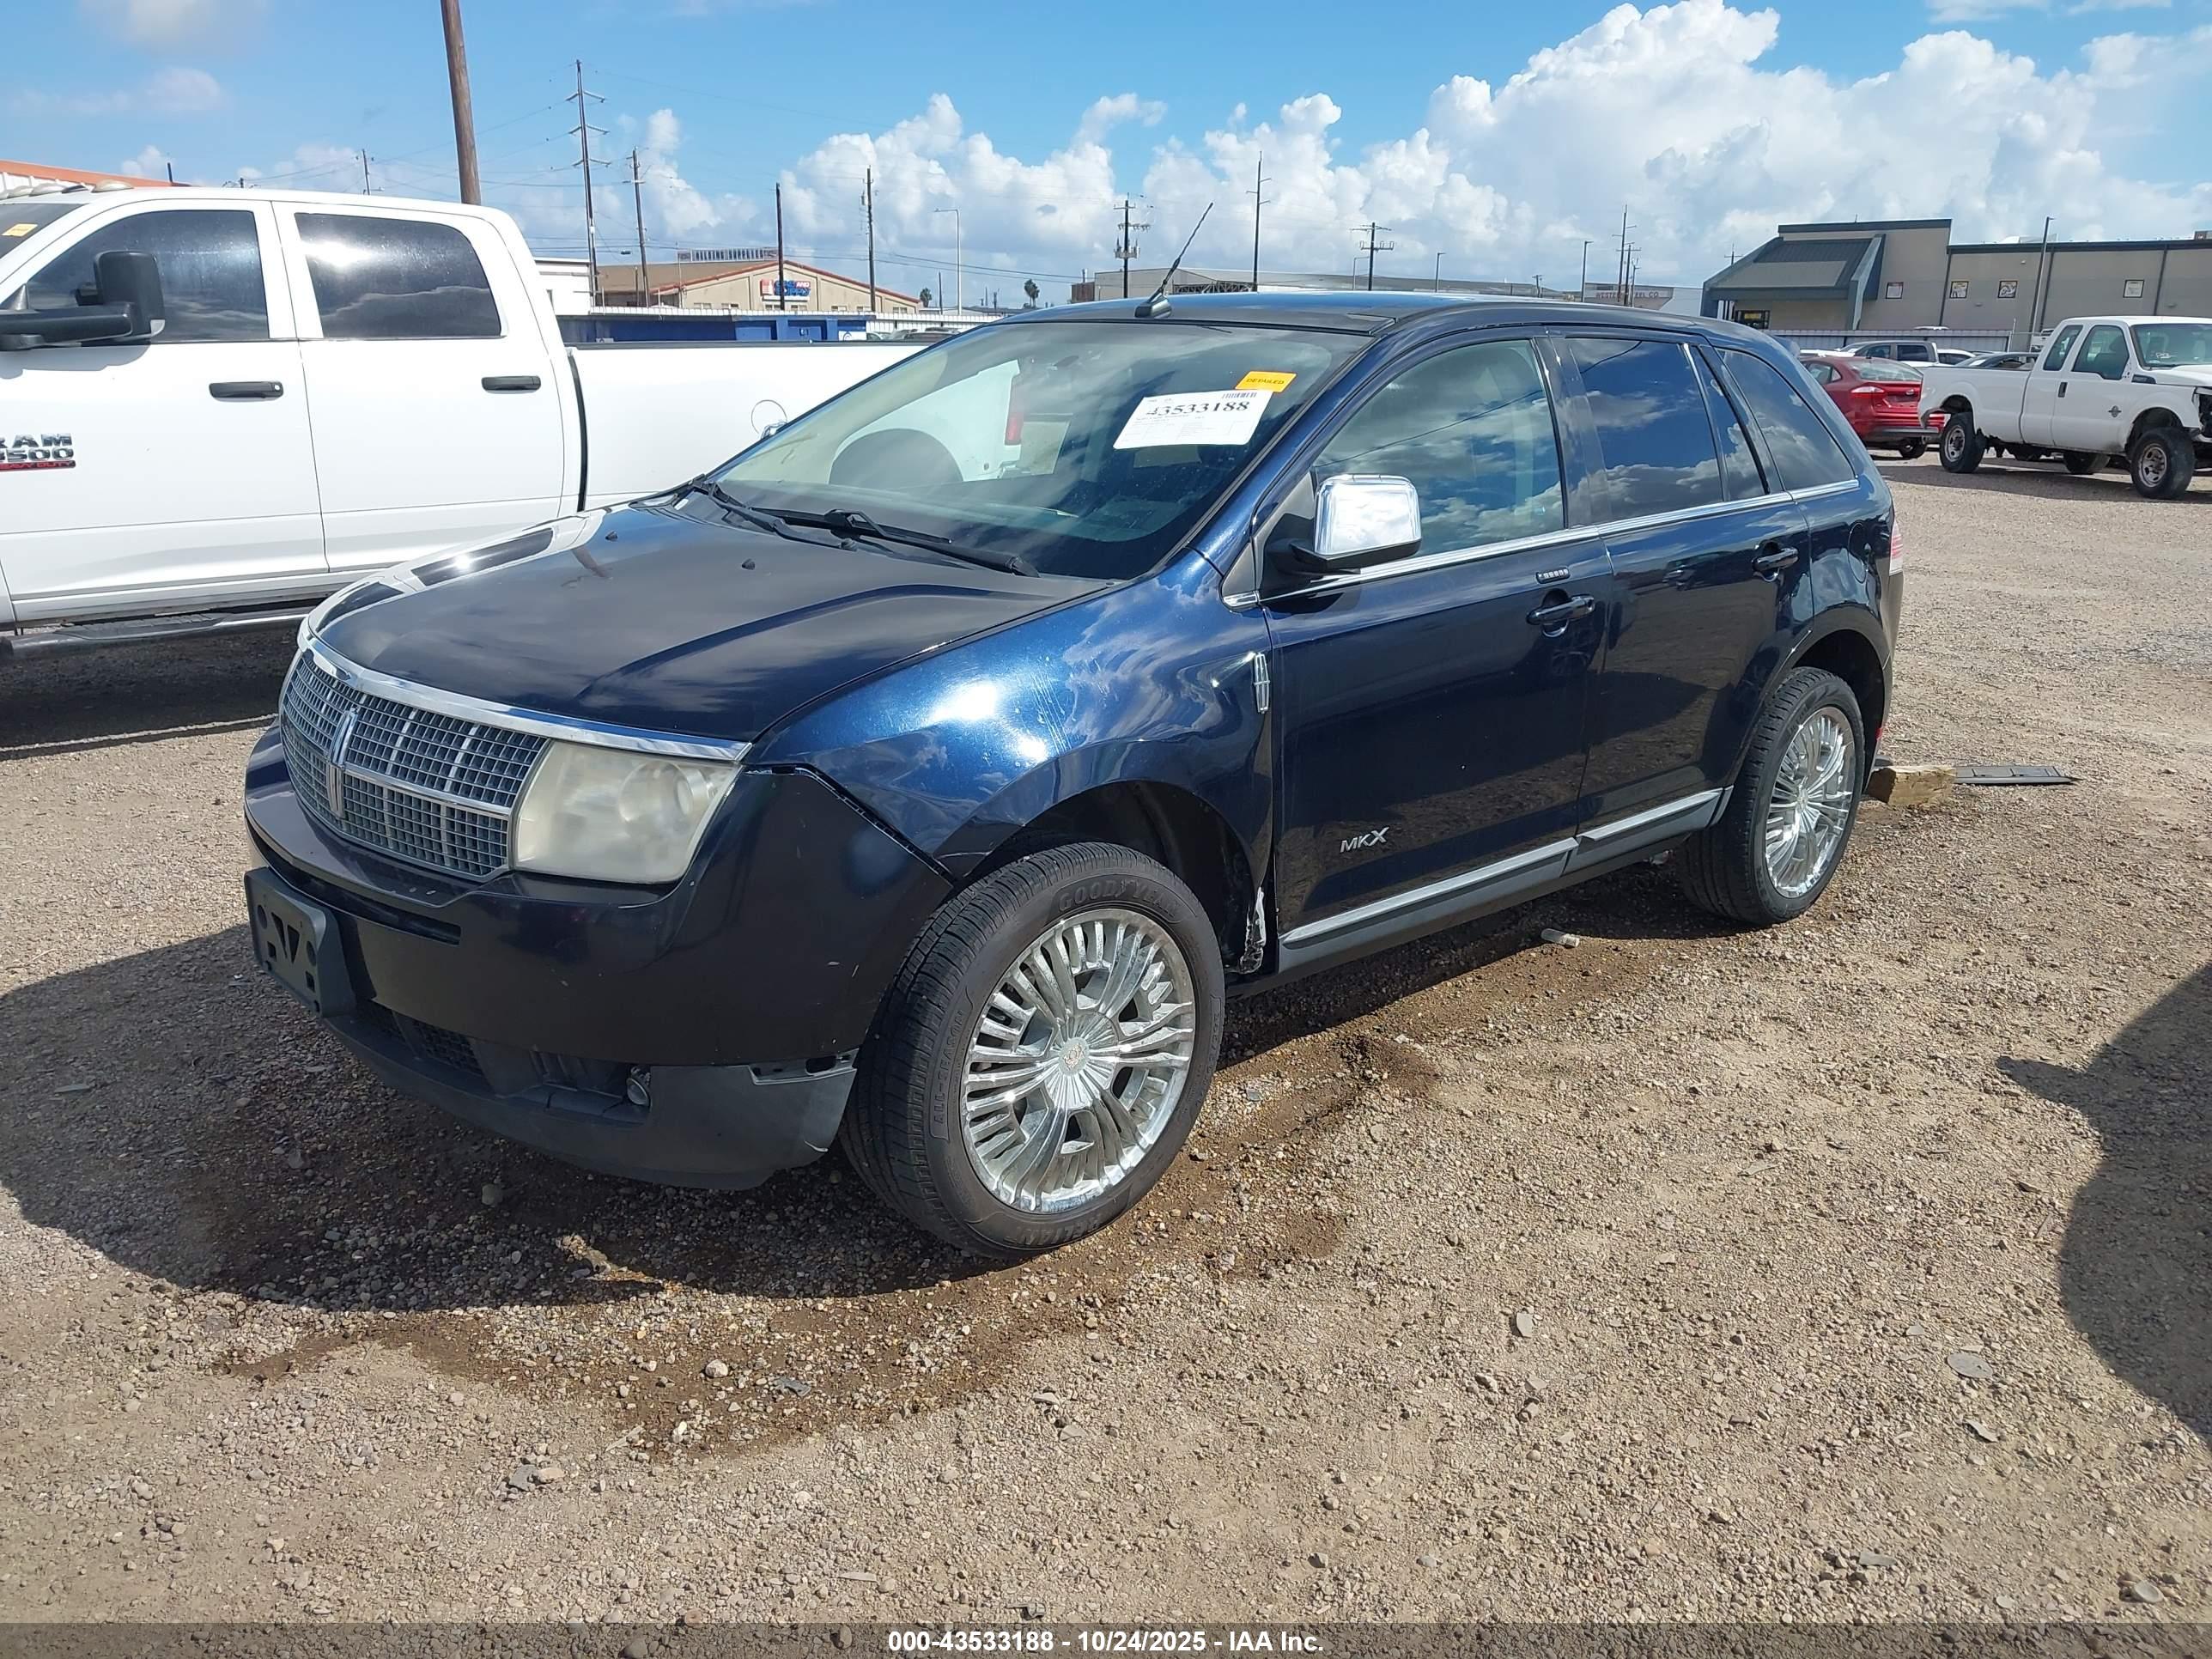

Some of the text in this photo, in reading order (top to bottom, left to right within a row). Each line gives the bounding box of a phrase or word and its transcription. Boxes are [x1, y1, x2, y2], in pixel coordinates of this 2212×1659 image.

[1146, 401, 1250, 416] 43533188
[0, 447, 74, 463] 500
[1340, 826, 1389, 853] MKX
